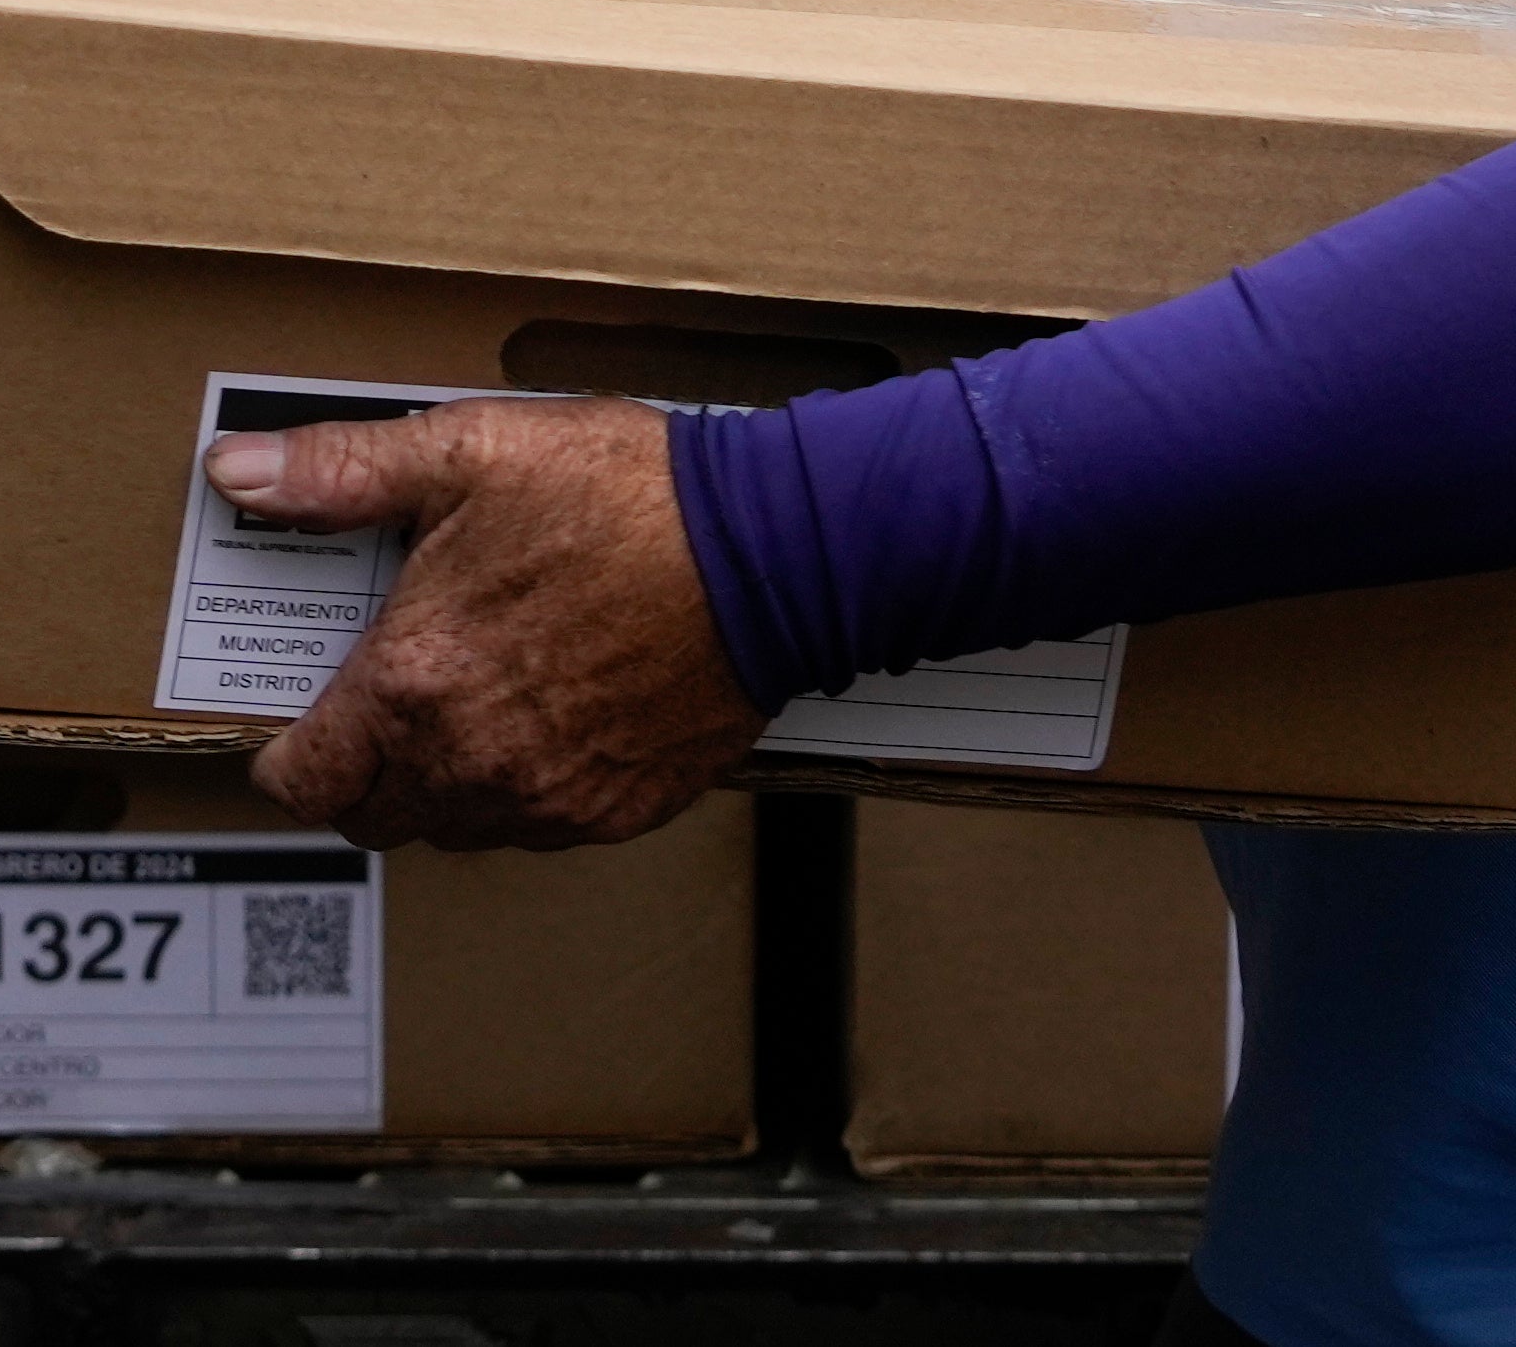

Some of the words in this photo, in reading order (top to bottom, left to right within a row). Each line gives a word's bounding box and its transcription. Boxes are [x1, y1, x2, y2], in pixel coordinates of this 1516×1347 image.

[195, 595, 361, 622] DEPARTAMENTO
[218, 634, 326, 657] MUNICIPIO
[218, 671, 313, 693] DISTRITO
